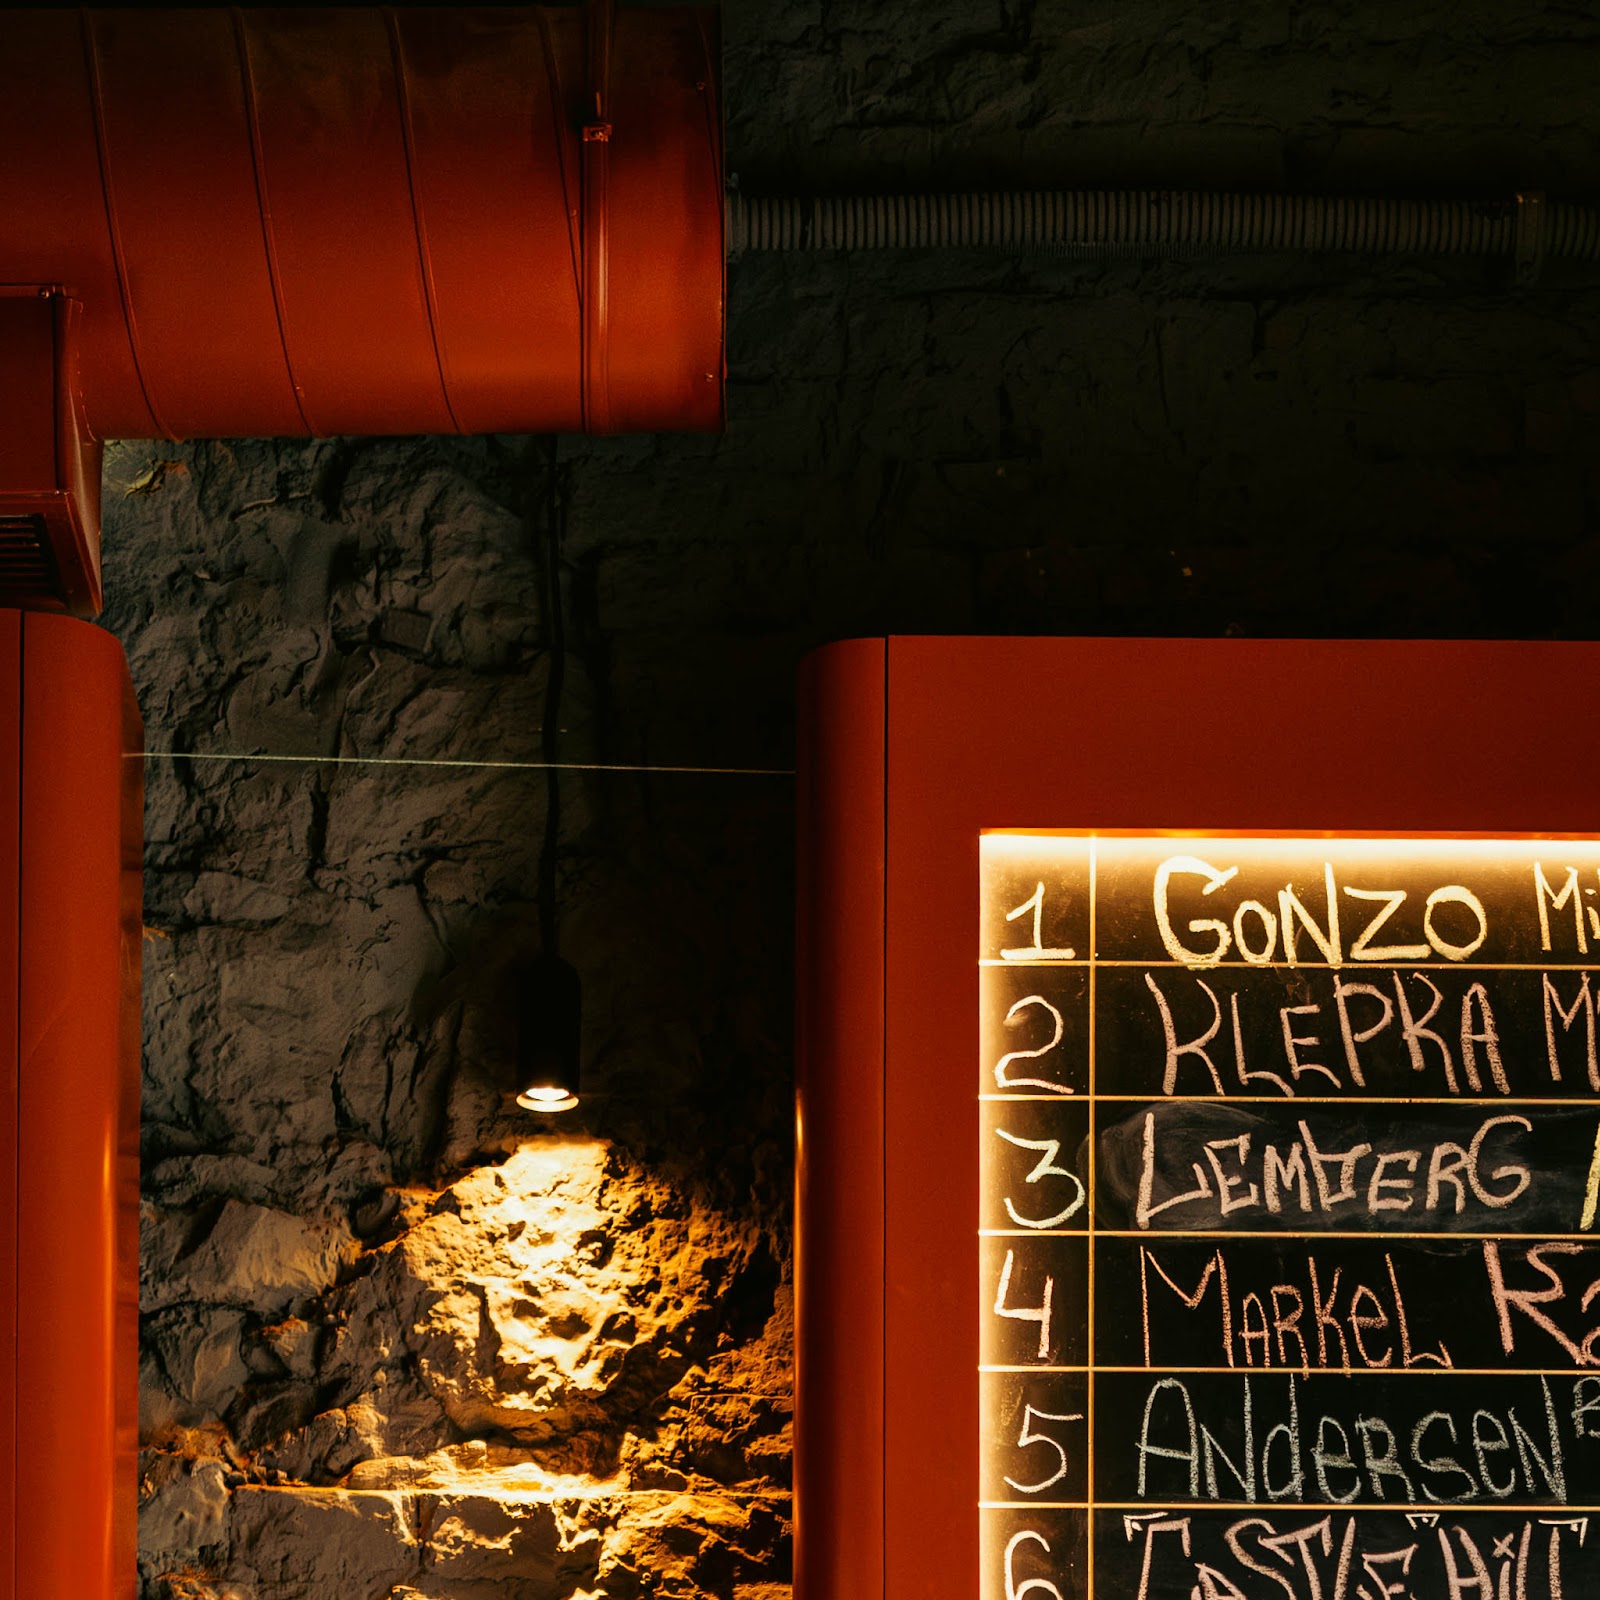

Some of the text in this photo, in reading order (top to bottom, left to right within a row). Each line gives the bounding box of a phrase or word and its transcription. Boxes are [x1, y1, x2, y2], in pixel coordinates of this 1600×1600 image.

[1001, 883, 1075, 960] 1
[994, 995, 1074, 1094] 2
[997, 1128, 1086, 1228] 3
[994, 1251, 1052, 1358] 4
[1003, 1404, 1083, 1493] 5
